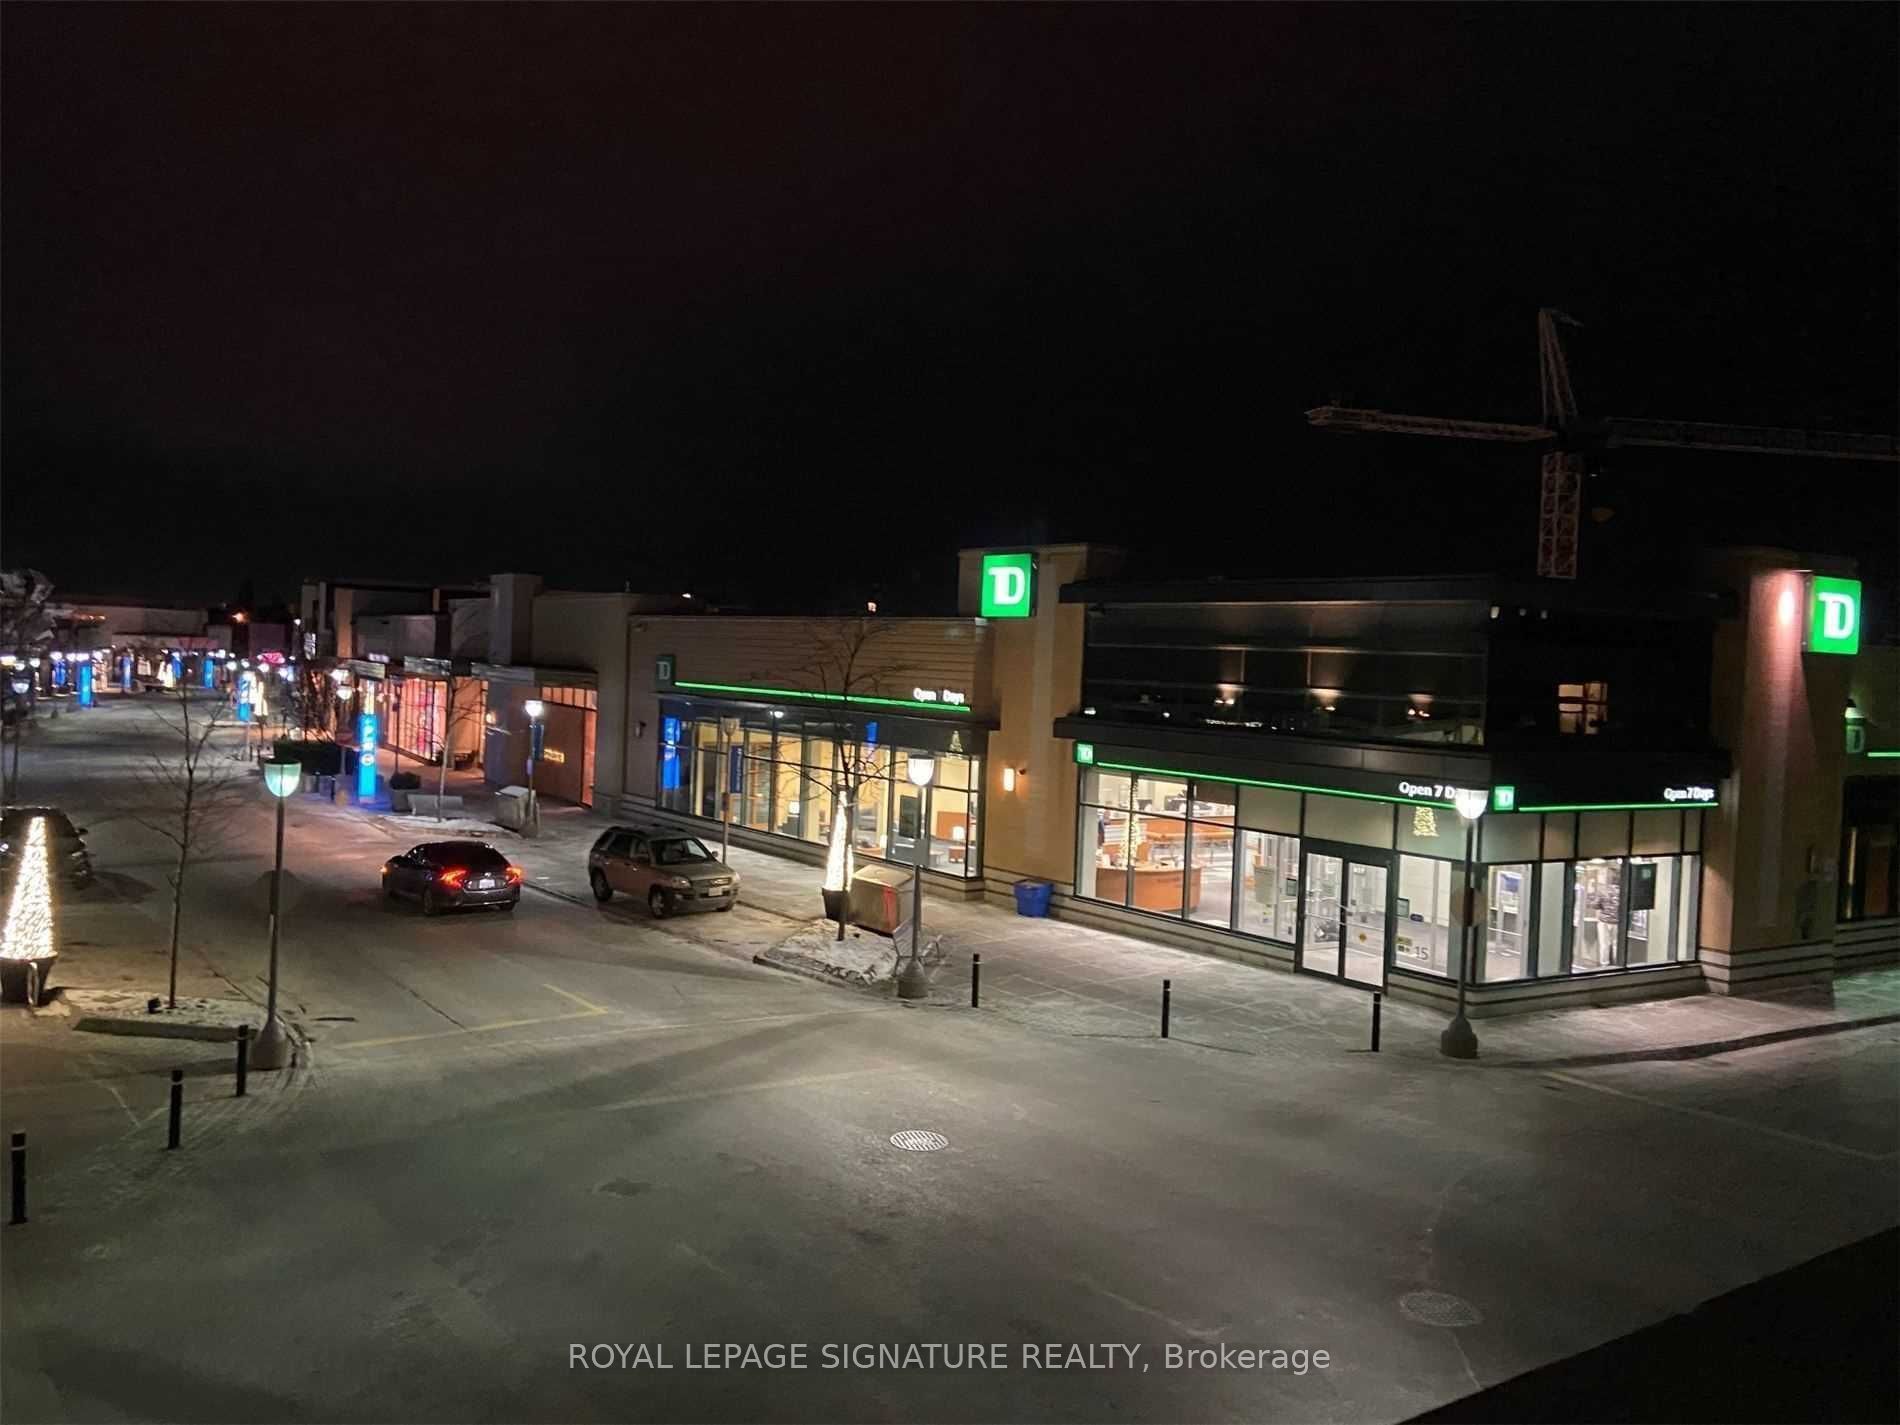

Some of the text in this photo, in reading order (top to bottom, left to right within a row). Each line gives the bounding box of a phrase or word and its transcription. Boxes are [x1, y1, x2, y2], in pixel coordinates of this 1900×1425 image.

[988, 566, 1026, 605] TD
[1818, 592, 1856, 640] TD
[1398, 781, 1433, 798] Open
[1433, 784, 1444, 798] 7
[1414, 945, 1430, 961] 15
